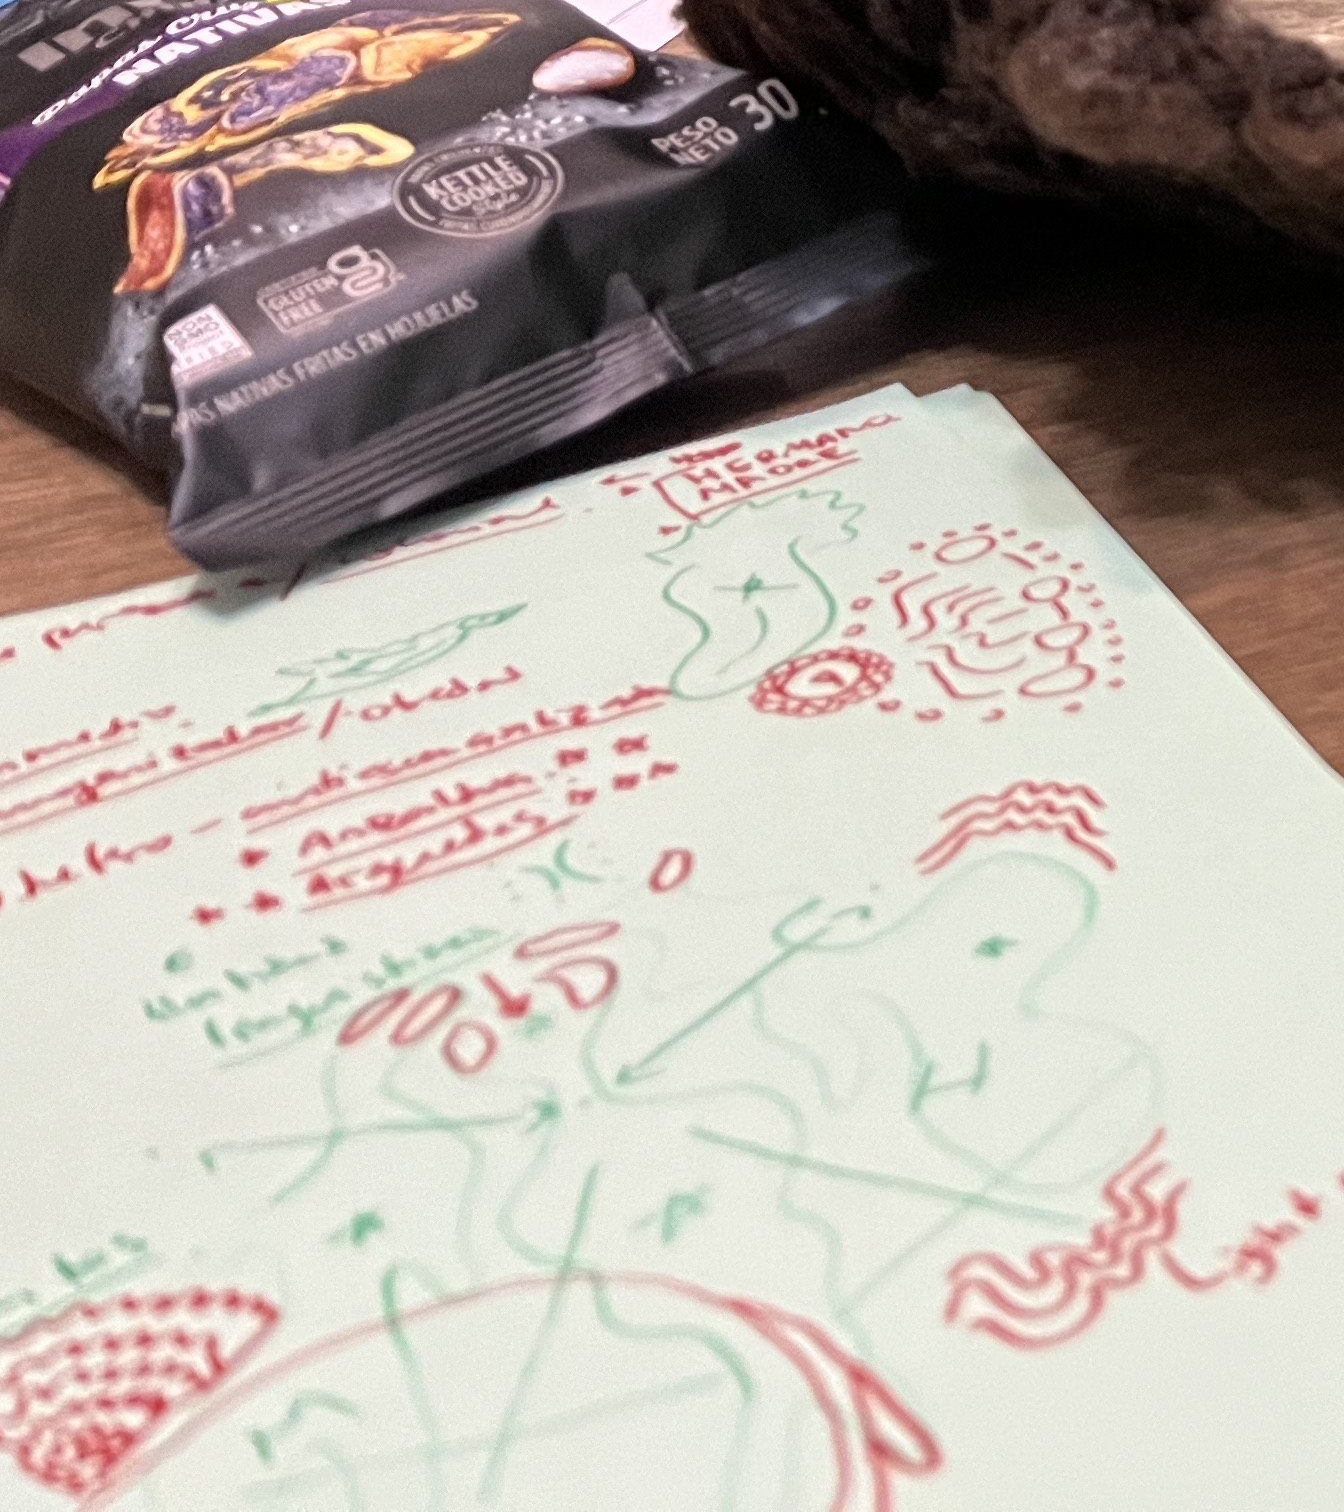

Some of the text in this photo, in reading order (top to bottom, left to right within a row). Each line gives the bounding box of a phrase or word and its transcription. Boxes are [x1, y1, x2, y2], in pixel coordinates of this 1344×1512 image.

[730, 76, 800, 131] 30
[650, 115, 718, 154] PESO
[669, 124, 739, 166] NETO
[421, 153, 519, 202] KETTLE
[439, 171, 529, 213] COOKED
[267, 274, 339, 313] GLUTEN
[278, 298, 325, 326] FREE
[212, 368, 296, 417] NATIVAS
[292, 340, 357, 384] FRITAS
[355, 327, 387, 356] EN
